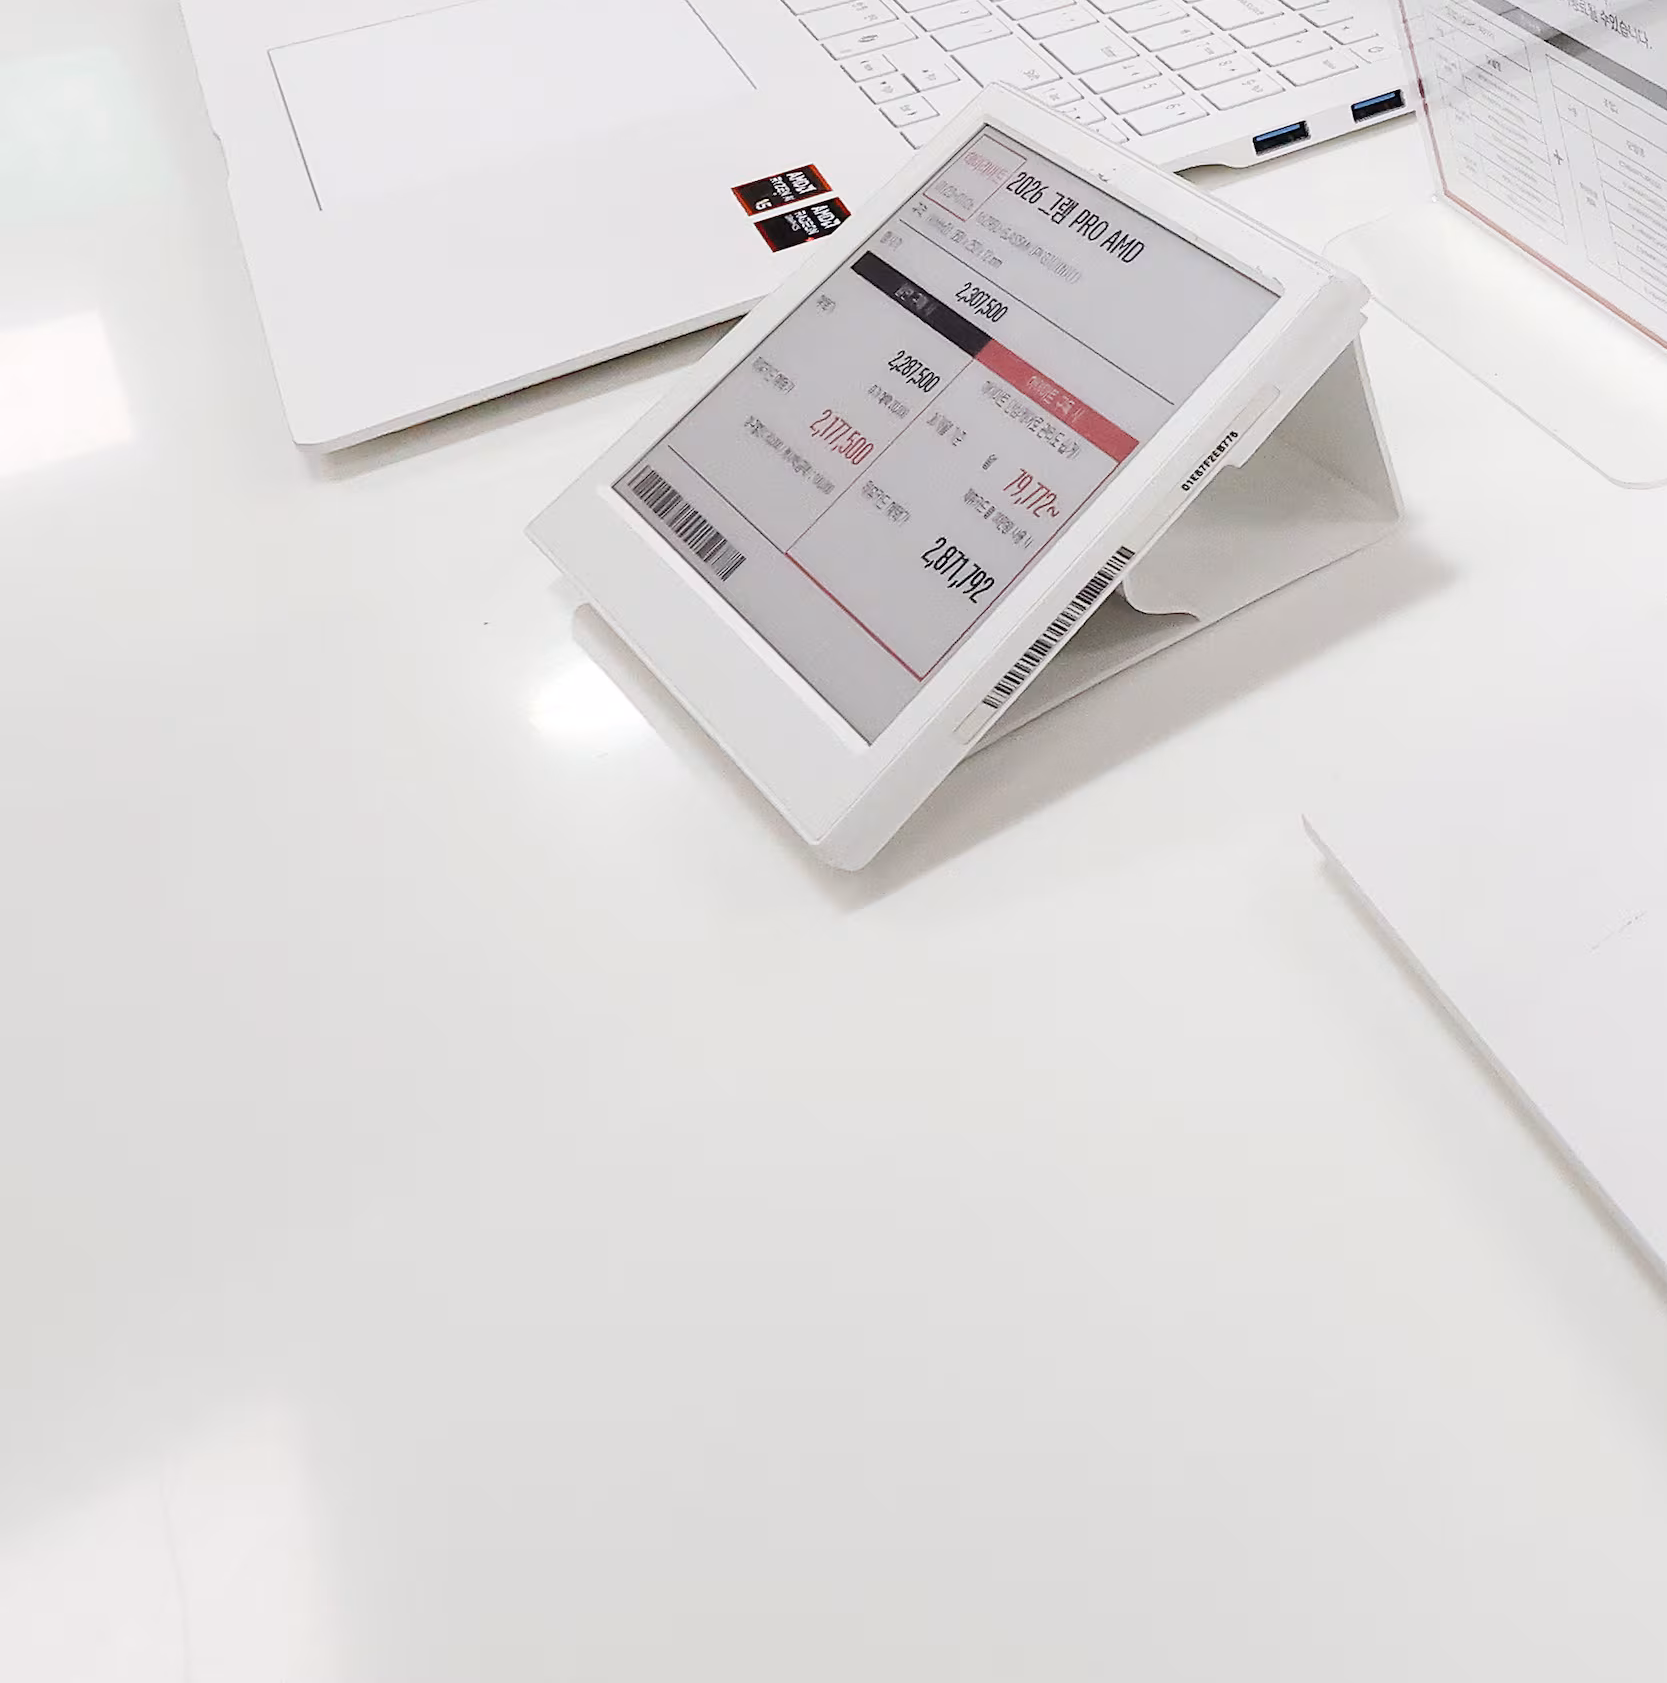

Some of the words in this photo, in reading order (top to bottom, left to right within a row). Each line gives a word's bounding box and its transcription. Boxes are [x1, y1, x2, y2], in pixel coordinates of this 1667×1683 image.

[786, 171, 817, 195] AMD
[811, 205, 841, 230] AMD
[1006, 172, 1049, 205] 2026
[1037, 192, 1079, 225] 그램
[1069, 209, 1108, 241] PRO
[1107, 230, 1145, 264] AMD
[954, 282, 1009, 323] 2,307,500
[888, 350, 941, 393] 2,287,500
[810, 409, 875, 465] 2,177,500
[921, 536, 995, 604] 2,871,792
